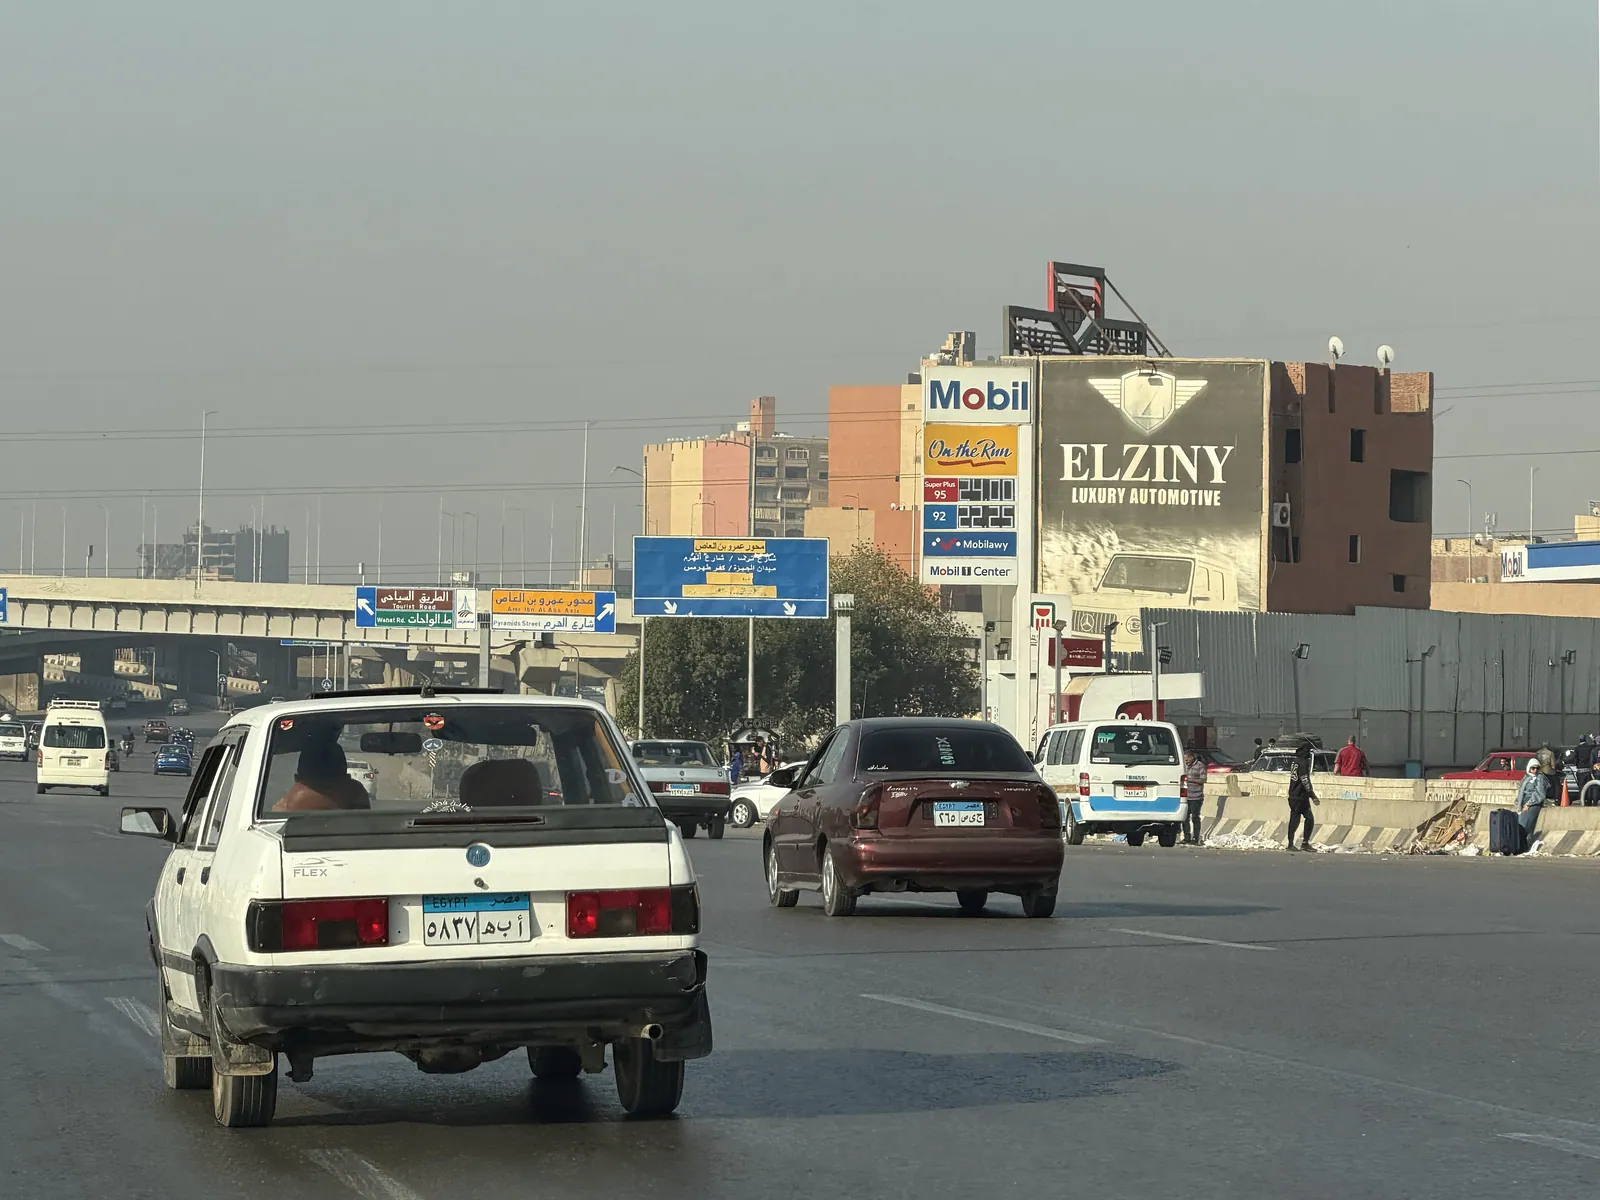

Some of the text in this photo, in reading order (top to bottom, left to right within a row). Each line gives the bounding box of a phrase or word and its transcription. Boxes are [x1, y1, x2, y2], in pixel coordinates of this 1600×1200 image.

[930, 380, 1028, 410] Mobil
[928, 438, 1013, 460] On the Run
[1060, 443, 1234, 484] ELZINY
[924, 481, 943, 489] Super
[934, 490, 947, 499] 95
[1072, 487, 1221, 507] LUXURY AUTOMOTIVE
[933, 511, 946, 521] 92
[959, 505, 1013, 528] 22.25
[728, 543, 744, 551] عمرو
[963, 540, 1008, 551] Mobilawy
[1501, 552, 1523, 576] Mobil
[930, 566, 959, 577] Mobil
[974, 566, 1010, 577] Center
[419, 591, 449, 605] الطريق
[495, 592, 525, 605] العاص
[527, 598, 537, 606] بن
[539, 598, 564, 606] عمرو
[493, 620, 521, 628] Pyramids
[543, 617, 594, 630] شارع الهرم
[293, 868, 328, 878] FLEX
[431, 896, 469, 909] EGYPT
[489, 895, 521, 907] مصر
[426, 915, 477, 941] ٥٨٣٧
